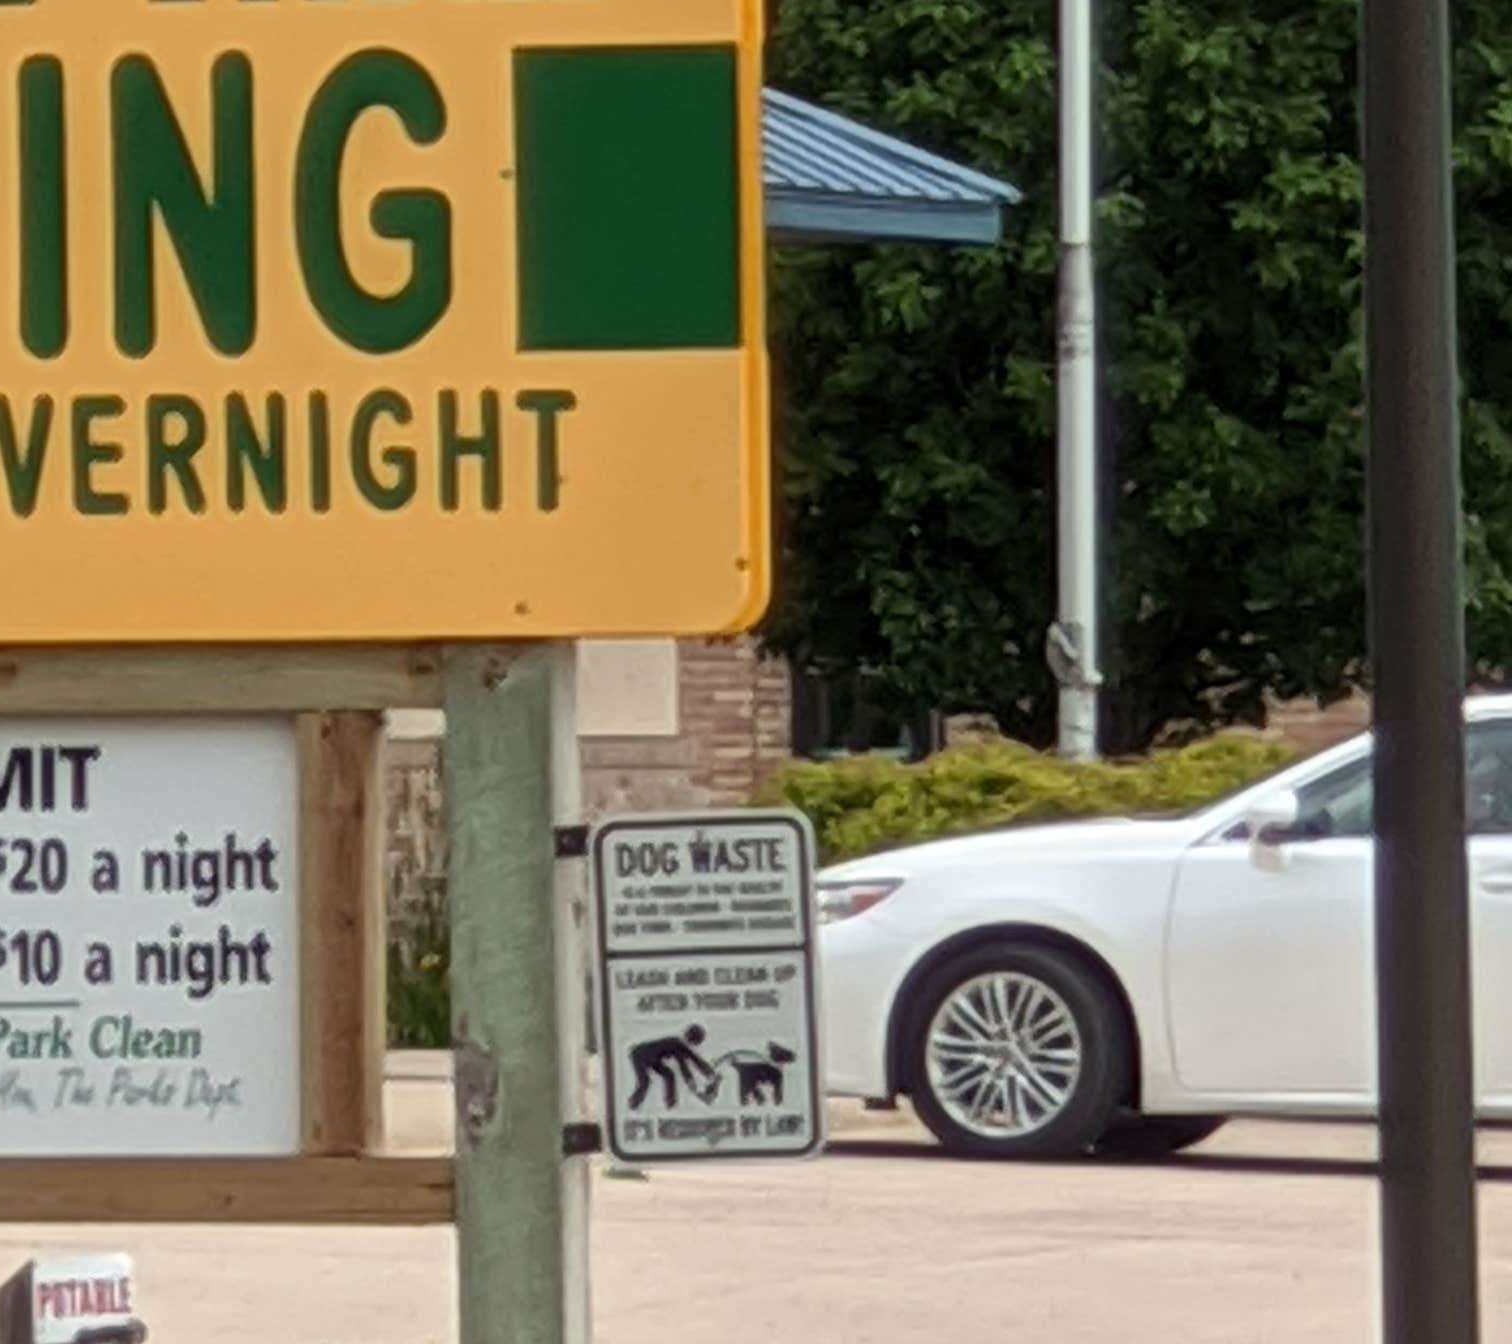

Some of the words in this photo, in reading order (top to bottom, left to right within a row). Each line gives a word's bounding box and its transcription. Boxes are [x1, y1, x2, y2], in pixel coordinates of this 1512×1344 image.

[91, 850, 120, 894] a
[142, 831, 279, 908] night
[615, 841, 681, 878] DOG
[688, 837, 788, 874] WASTE
[84, 941, 113, 986] a
[136, 924, 272, 999] night
[89, 1014, 203, 1059] Clean
[36, 1276, 132, 1318] POTABLE
